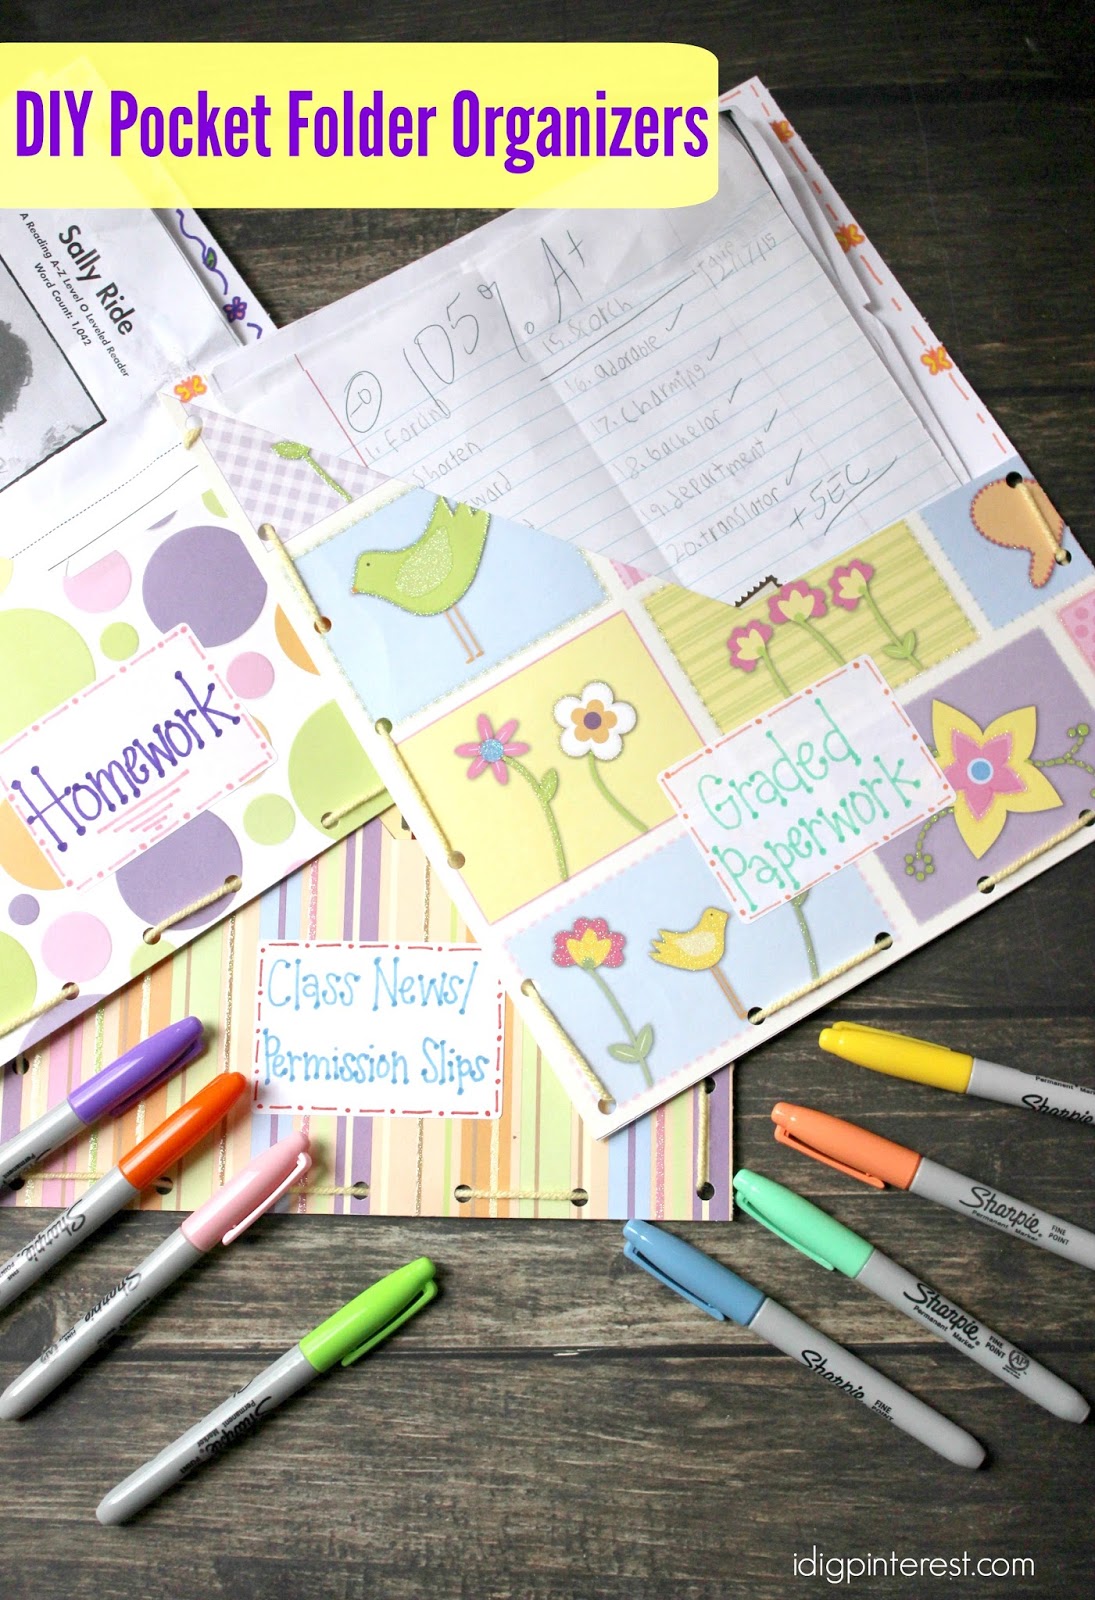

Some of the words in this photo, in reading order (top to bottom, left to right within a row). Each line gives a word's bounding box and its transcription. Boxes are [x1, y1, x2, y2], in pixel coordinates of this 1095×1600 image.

[19, 212, 29, 221] A
[25, 221, 52, 259] Reading
[62, 277, 84, 303] Level
[79, 303, 89, 313] O
[85, 313, 111, 346] Leveled
[106, 346, 130, 377] Reader
[58, 224, 102, 283] Sally
[95, 282, 136, 336] Ride
[541, 230, 586, 324] A+
[34, 262, 56, 289] Word
[51, 289, 74, 320] Count:
[71, 320, 92, 347] 1,042
[593, 335, 664, 380] adorable
[645, 408, 722, 462] bachelor
[667, 438, 768, 510] department
[11, 670, 241, 852] Homework
[697, 697, 862, 831] Graded
[711, 755, 922, 912] Paperwork
[267, 957, 361, 1011] Class
[372, 956, 479, 1015] News/
[262, 1027, 409, 1086] Permission
[420, 1036, 491, 1096] Slips
[1021, 1093, 1095, 1126] Sharpie
[958, 1186, 1041, 1237] Sharpie
[971, 1209, 1009, 1229] Permanent
[1014, 1228, 1039, 1243] Marker
[1051, 1224, 1067, 1237] FINE
[1048, 1232, 1070, 1247] POINT
[903, 1282, 979, 1341] Sharpie
[913, 1304, 949, 1332] Permanent
[951, 1331, 976, 1350] Marker
[984, 1342, 1007, 1360] POINT
[988, 1335, 1005, 1349] FINE
[222, 1399, 257, 1428] Permanent
[875, 1399, 892, 1414] FINE
[197, 1428, 220, 1447] Marker
